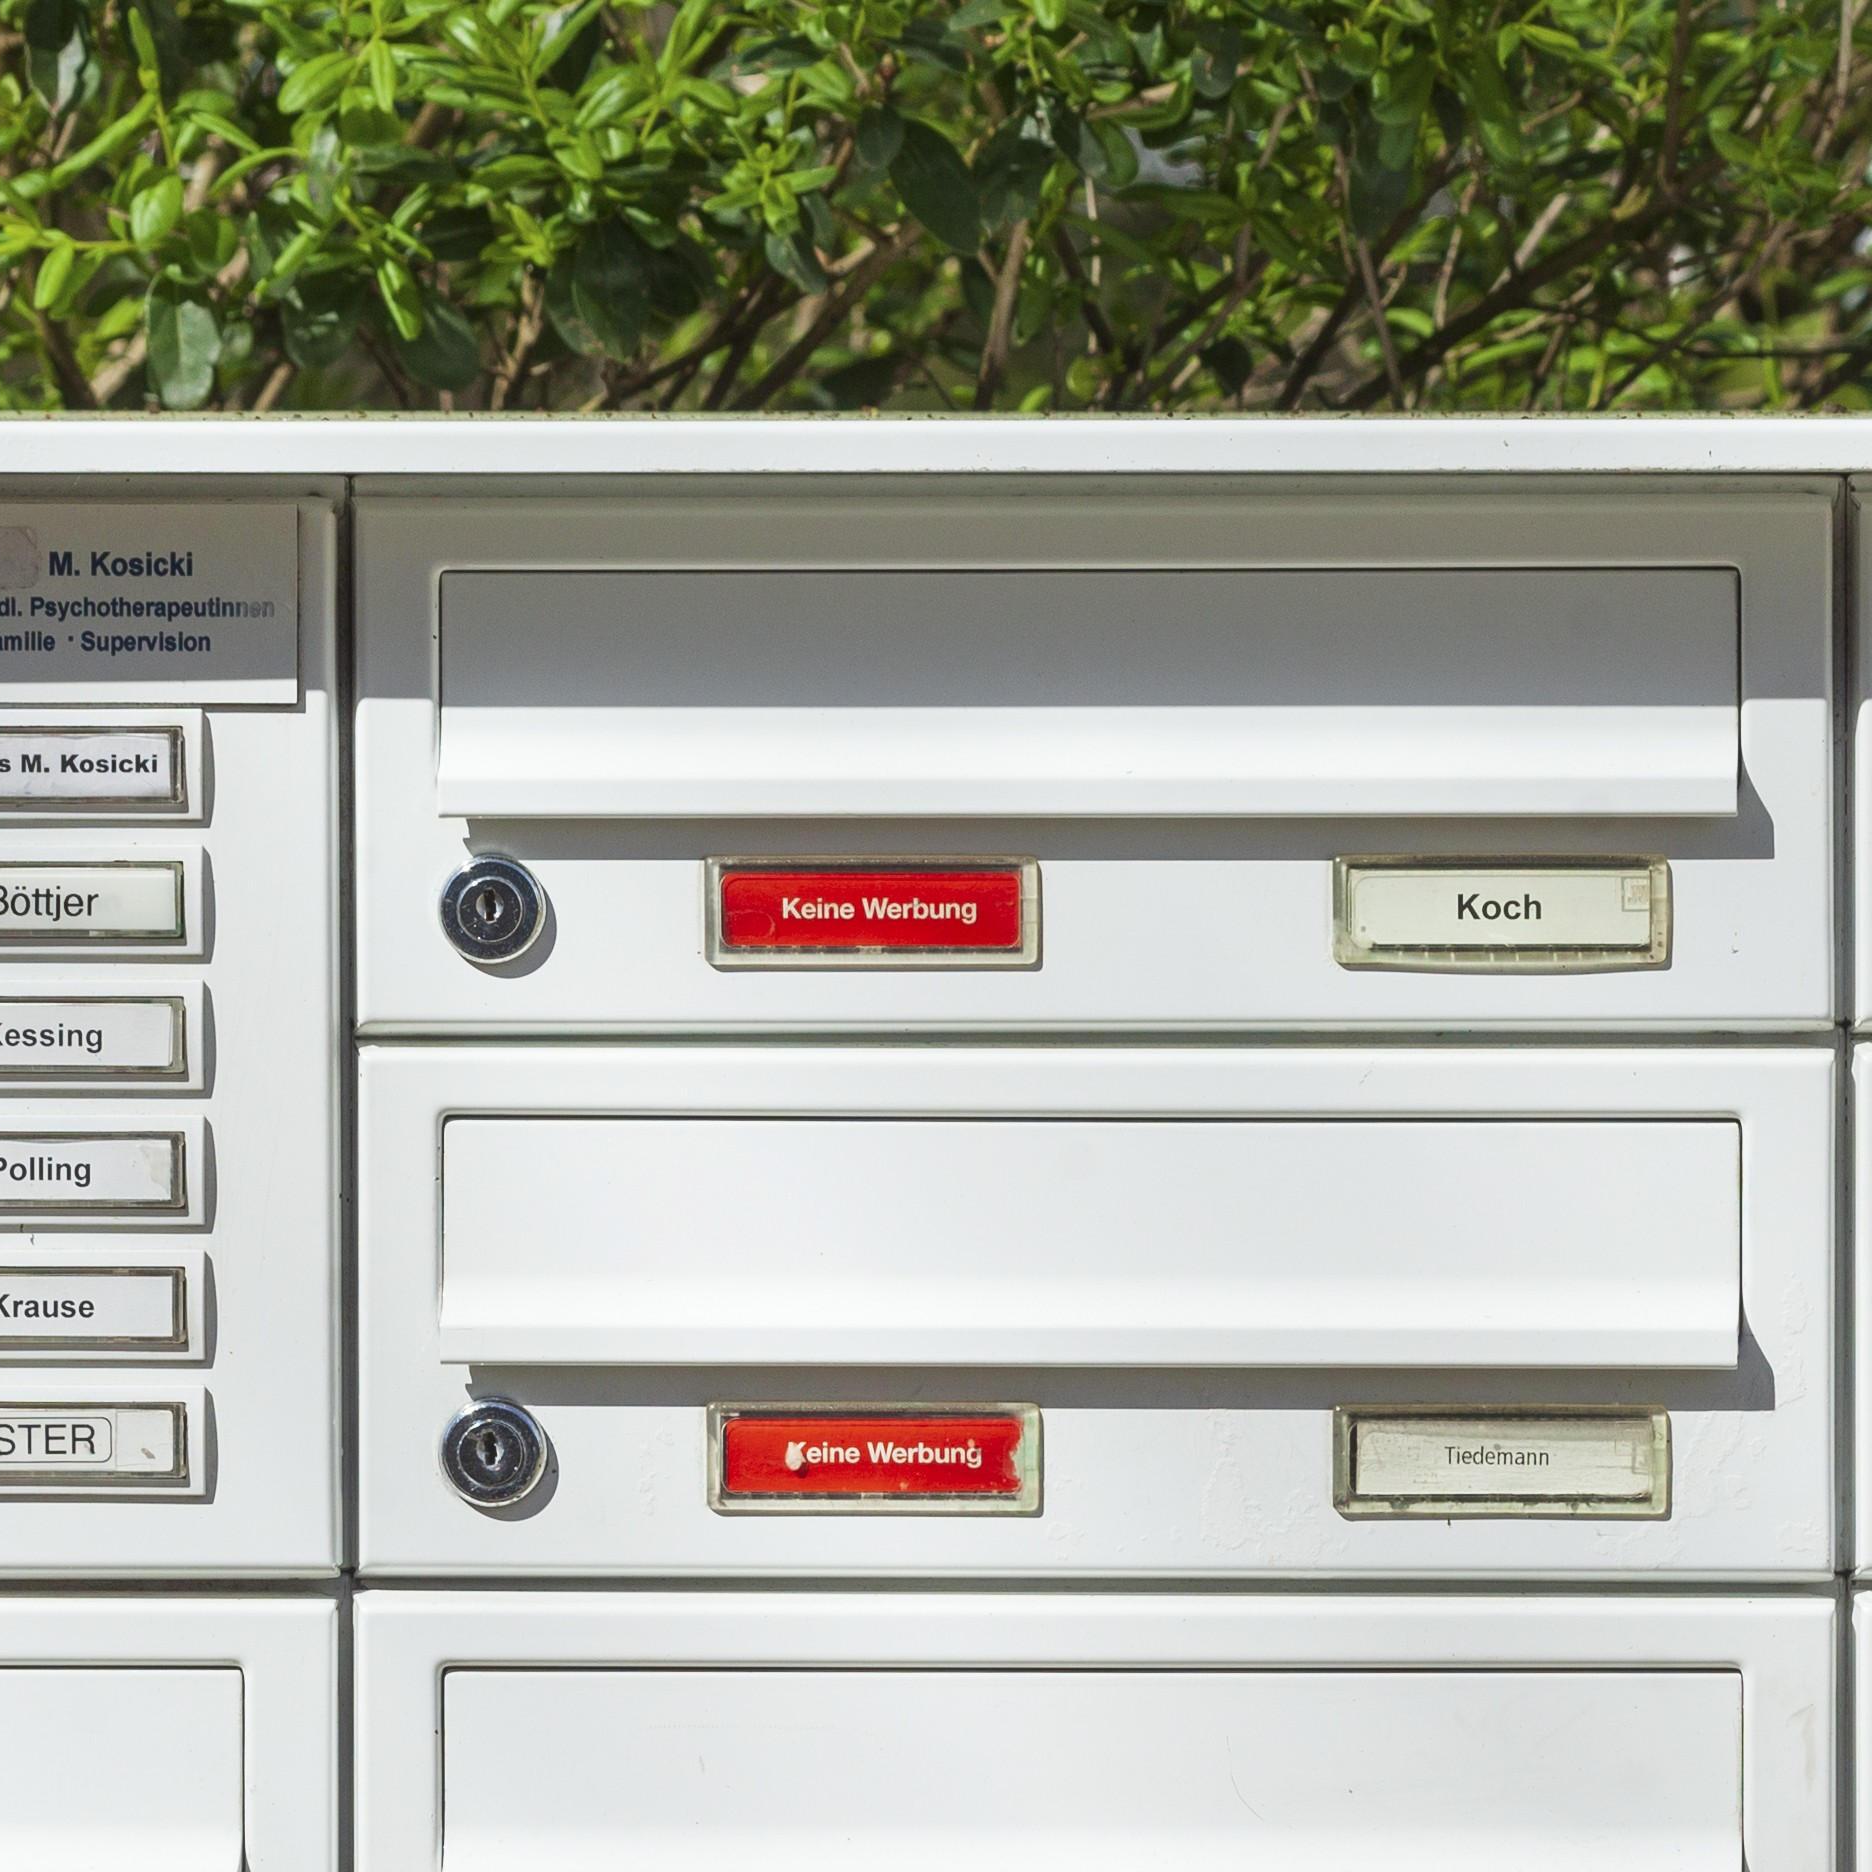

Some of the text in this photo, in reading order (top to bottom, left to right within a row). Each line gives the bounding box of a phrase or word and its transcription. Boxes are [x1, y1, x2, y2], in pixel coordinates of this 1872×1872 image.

[49, 552, 193, 577] M. Kosicki
[81, 631, 211, 656] Supervision
[21, 754, 50, 773] M.
[61, 754, 158, 773] Kosicki
[783, 898, 977, 924] Keine Werbung
[1458, 893, 1541, 920] Koch
[867, 1441, 982, 1468] Werbung
[1445, 1446, 1549, 1466] Tiedemann
